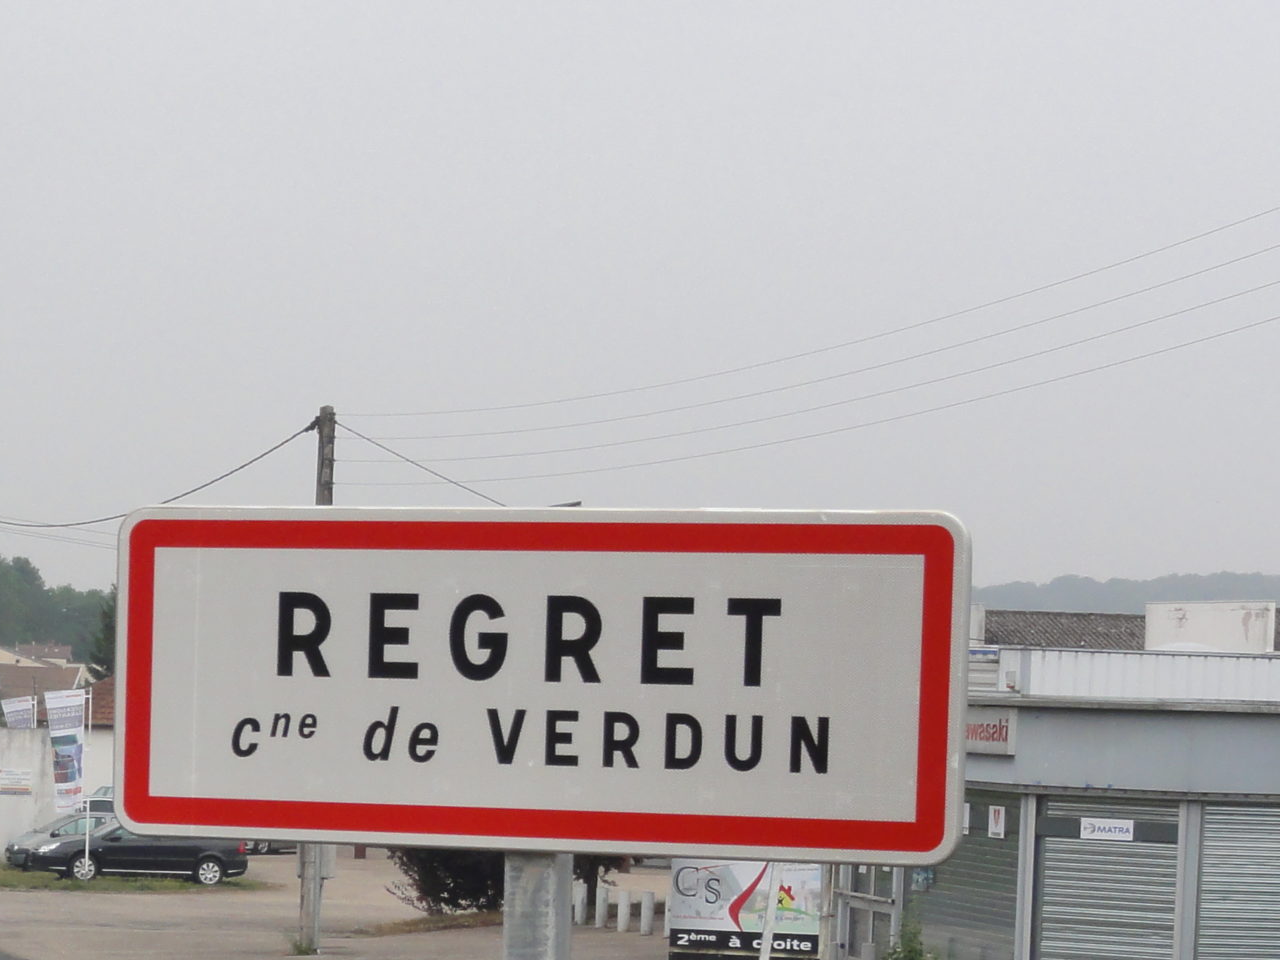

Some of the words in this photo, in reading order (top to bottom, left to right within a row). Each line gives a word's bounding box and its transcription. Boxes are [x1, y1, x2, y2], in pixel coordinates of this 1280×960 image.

[275, 590, 782, 687] REGRET
[363, 706, 439, 762] de
[487, 708, 830, 774] VERDUN
[966, 718, 1009, 742] awasaki
[1096, 825, 1130, 835] MATRA
[676, 932, 717, 946] 2ème
[728, 935, 741, 948] à
[752, 938, 813, 951] doite
